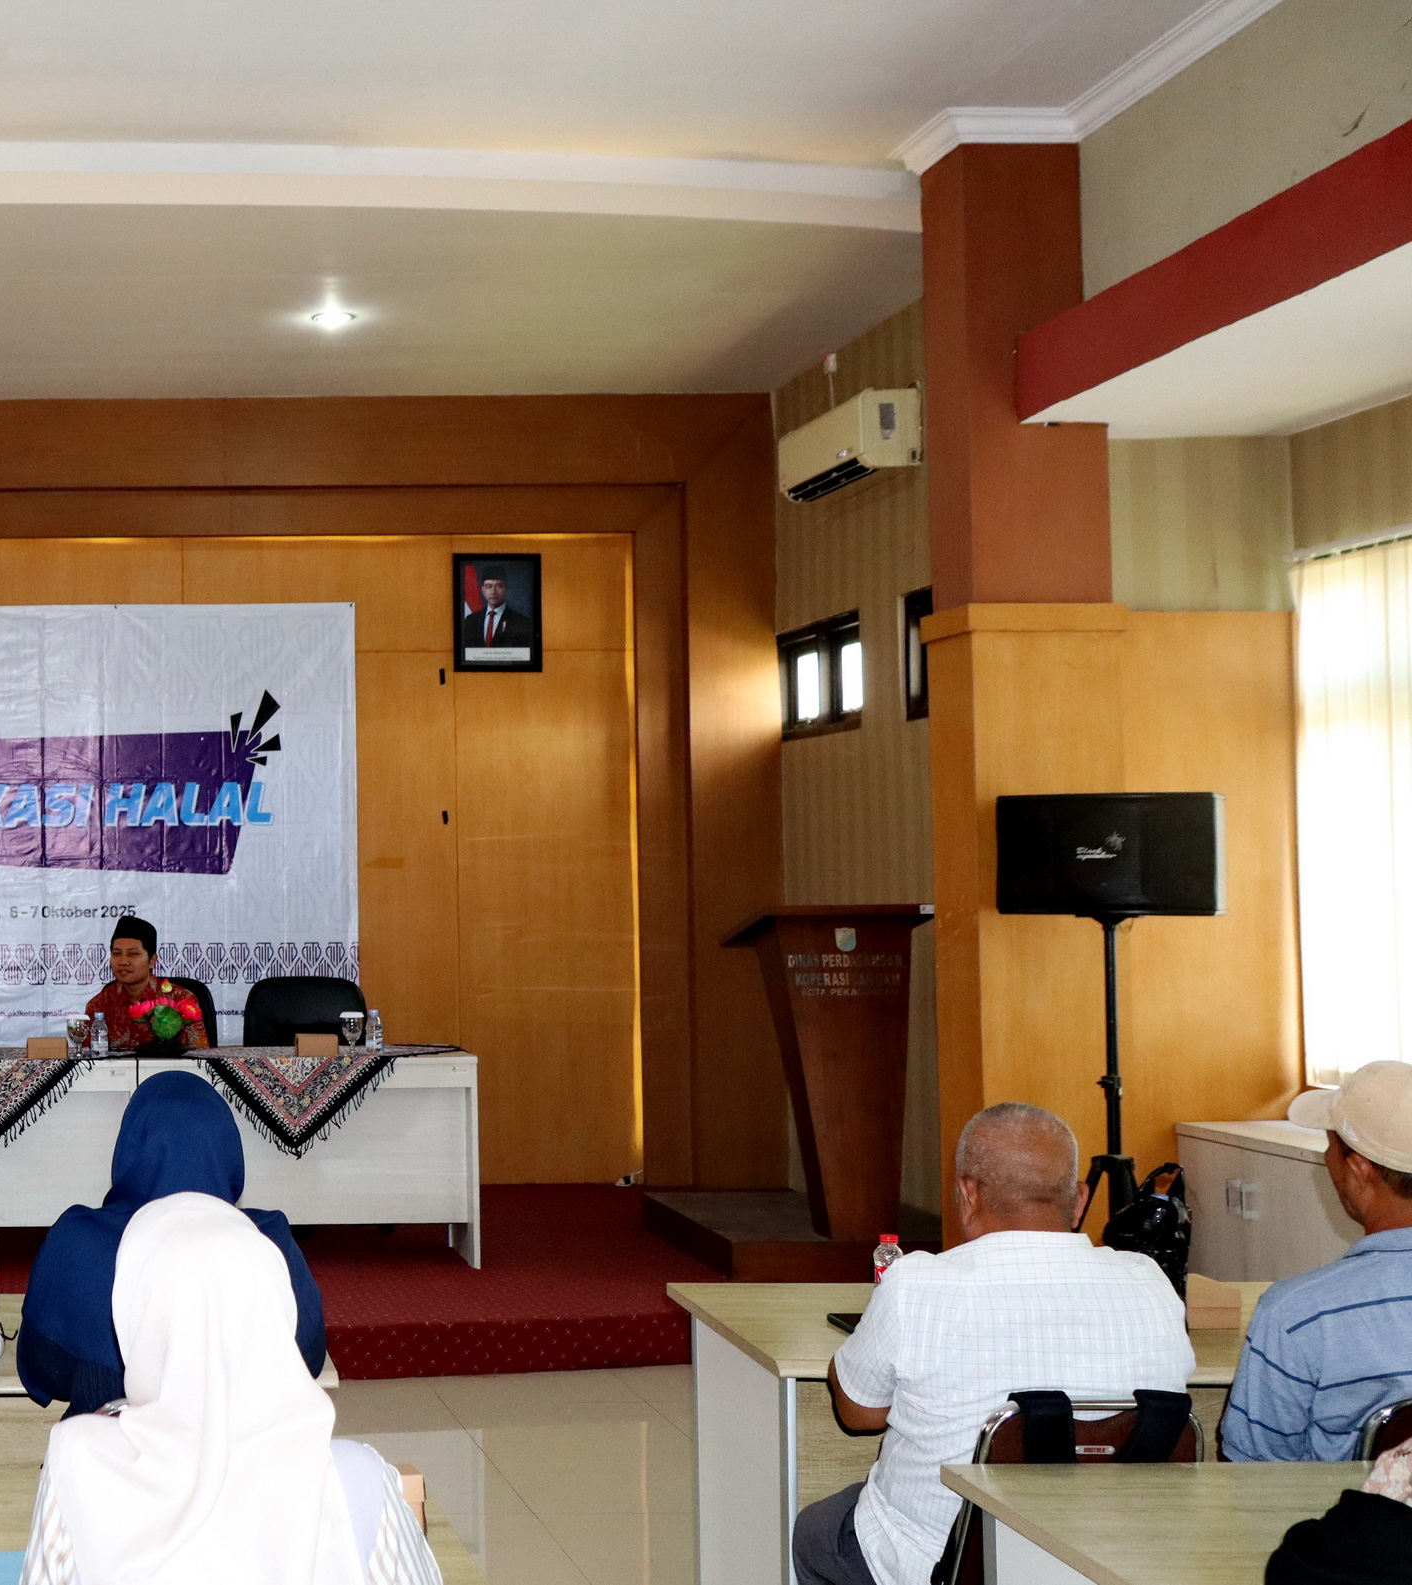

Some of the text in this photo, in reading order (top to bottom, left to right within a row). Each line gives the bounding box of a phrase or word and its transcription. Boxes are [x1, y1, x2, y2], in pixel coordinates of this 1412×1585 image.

[104, 781, 275, 827] HALAL
[42, 905, 98, 918] Oktober
[100, 905, 136, 918] 2025
[795, 973, 850, 986] KOPERASI
[801, 988, 826, 996] KOTA
